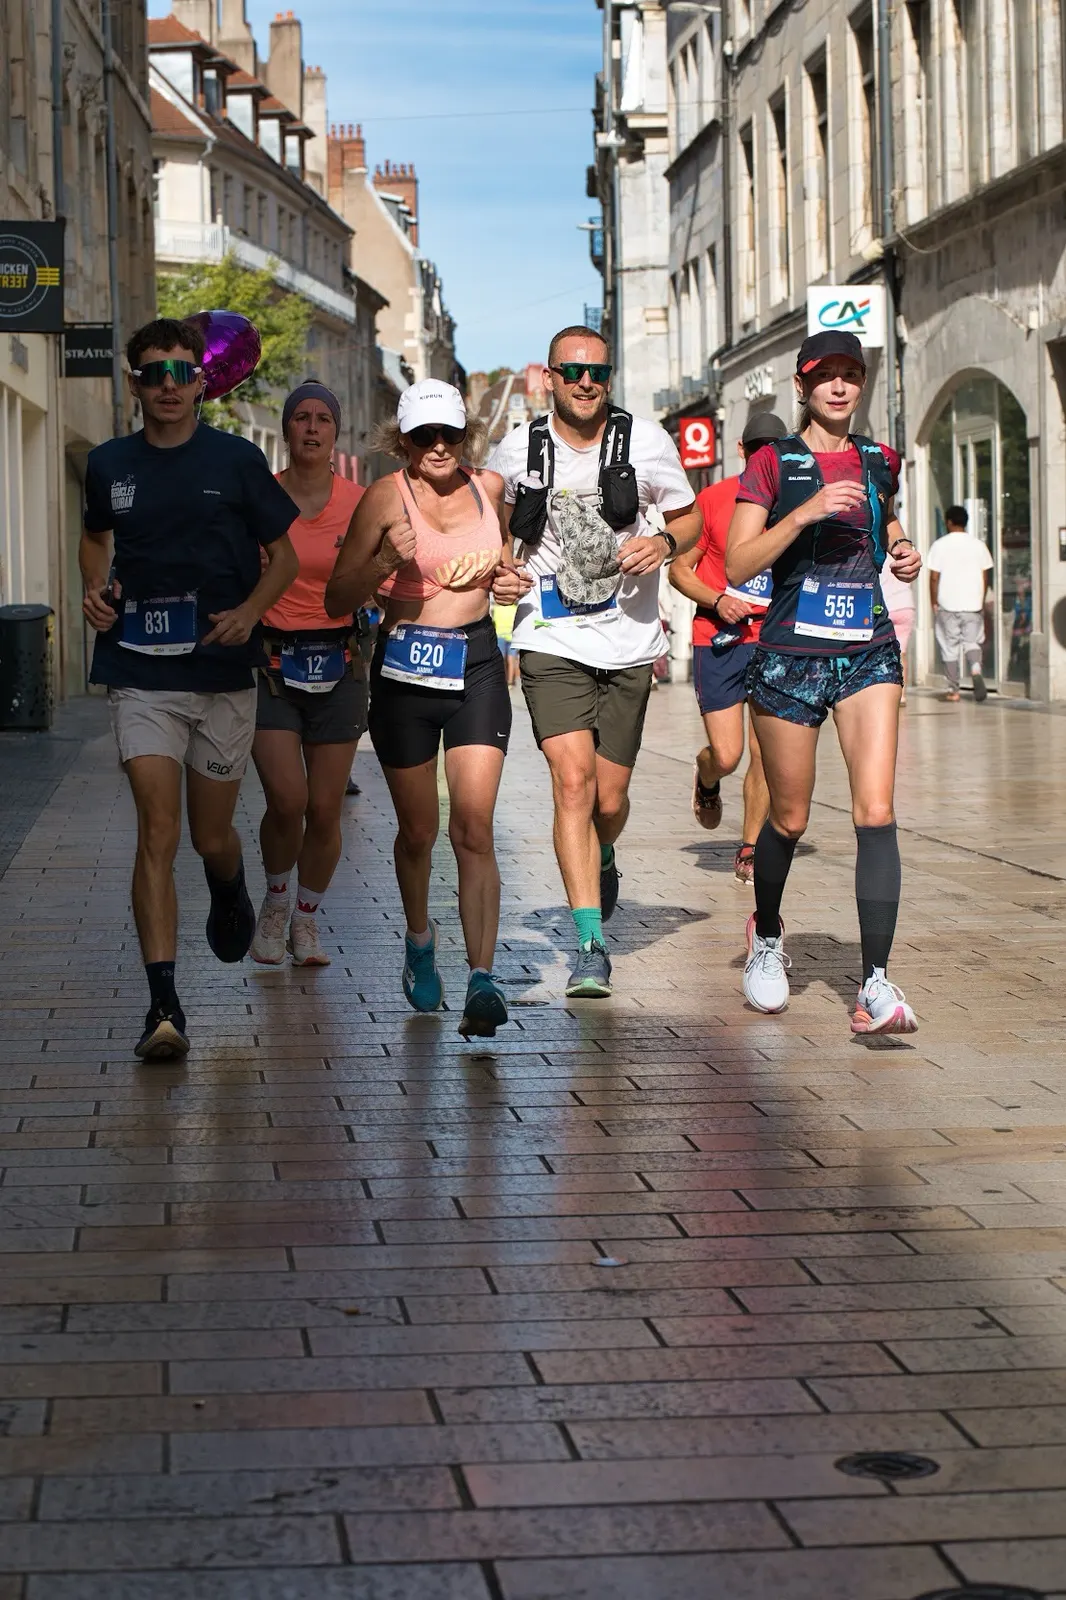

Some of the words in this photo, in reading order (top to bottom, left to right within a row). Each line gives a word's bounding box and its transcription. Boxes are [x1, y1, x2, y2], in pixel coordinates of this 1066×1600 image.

[818, 300, 870, 327] CA
[65, 348, 114, 359] STRATUS
[685, 422, 710, 453] Q
[824, 594, 854, 618] 555
[145, 610, 169, 634] 831
[306, 655, 323, 674] 12
[409, 641, 444, 667] 620
